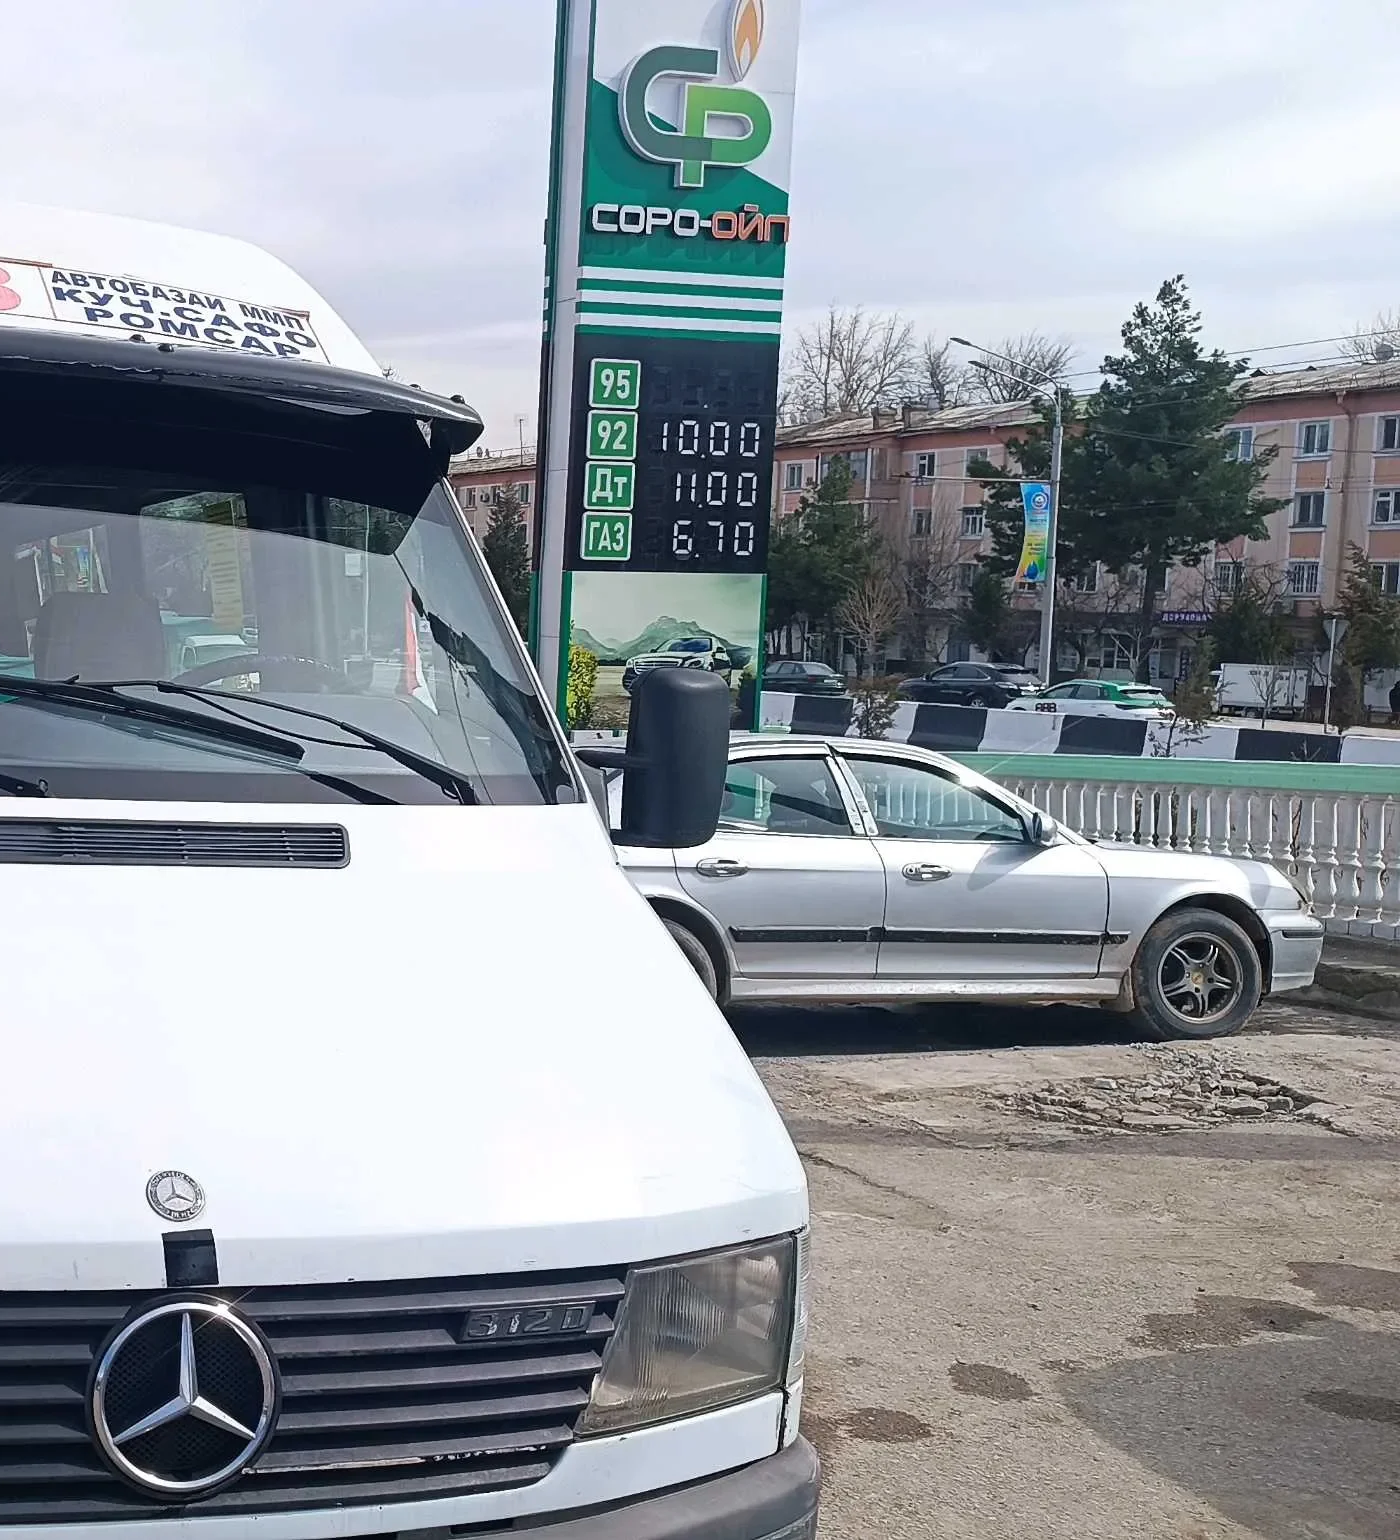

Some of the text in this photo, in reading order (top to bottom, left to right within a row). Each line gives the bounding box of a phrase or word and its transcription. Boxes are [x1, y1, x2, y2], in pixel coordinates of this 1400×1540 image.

[51, 270, 304, 331] АВТОБАЗАИ ММП
[84, 306, 300, 356] РОМСАР
[600, 368, 631, 400] 95
[597, 420, 627, 450] 92
[588, 520, 754, 558] ГАЗ 6.70
